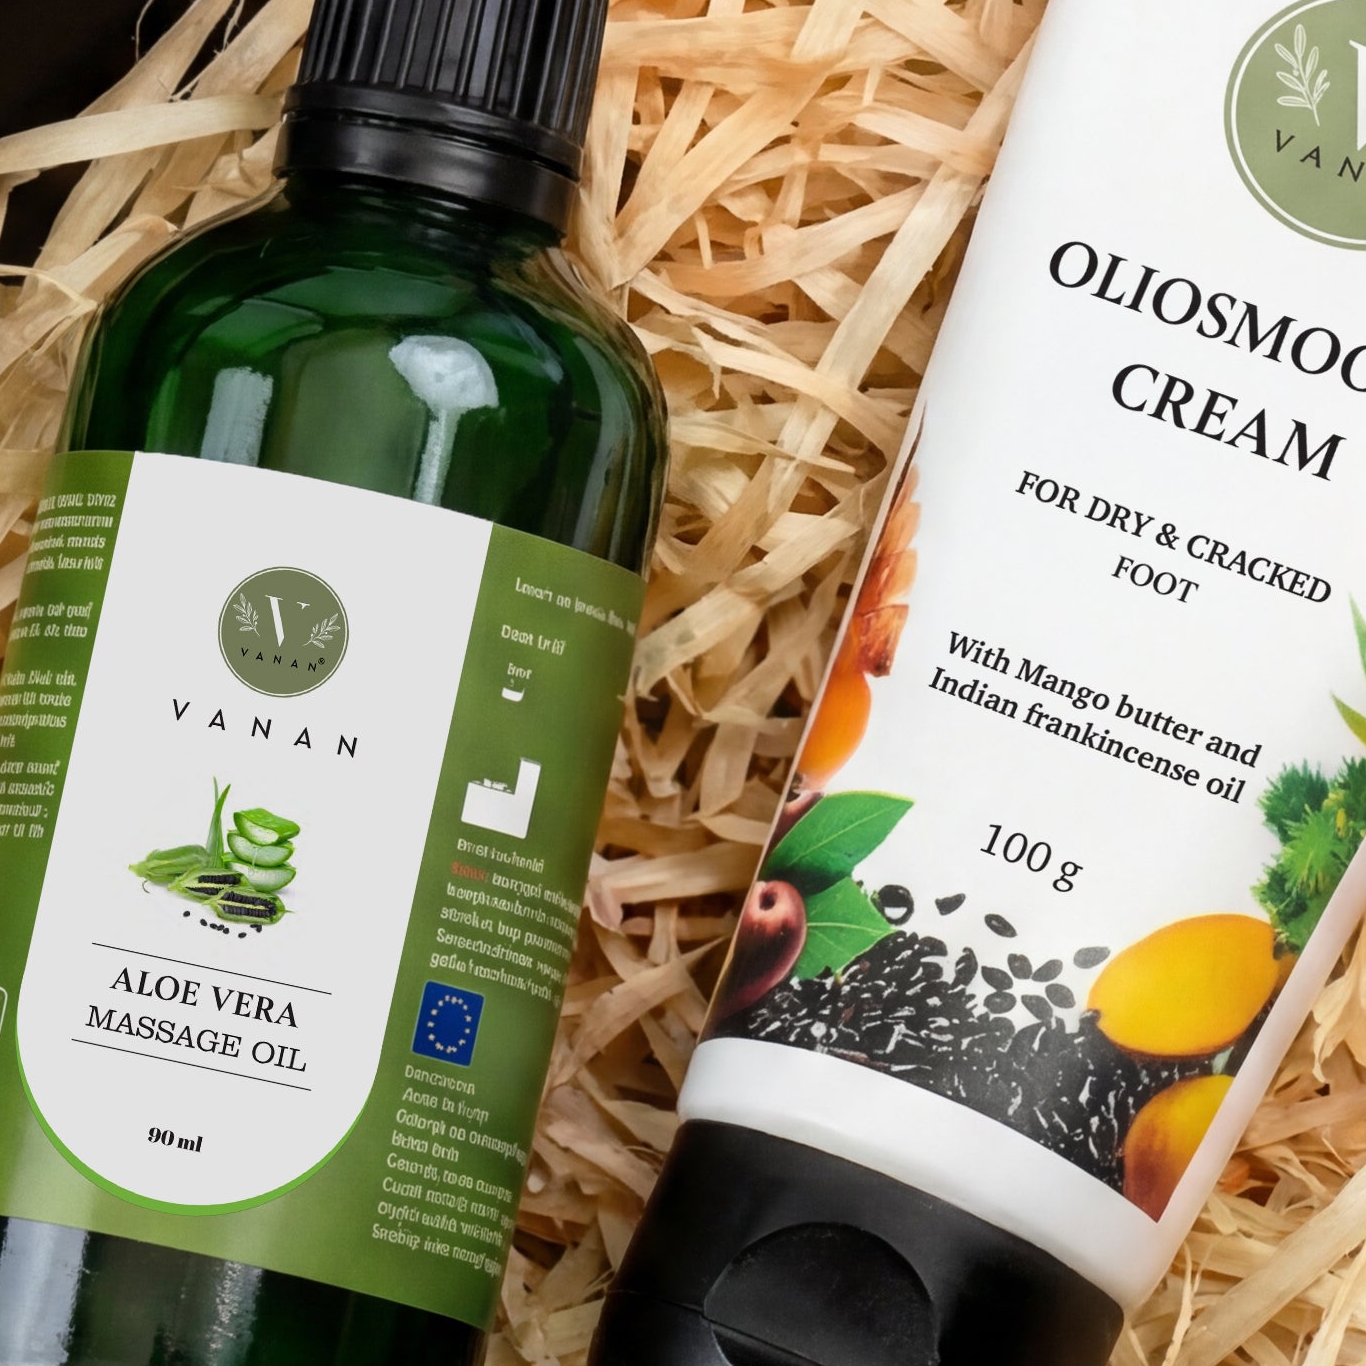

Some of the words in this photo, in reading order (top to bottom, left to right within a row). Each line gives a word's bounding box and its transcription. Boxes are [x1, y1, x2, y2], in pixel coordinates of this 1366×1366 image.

[1111, 363, 1347, 482] CREAM
[1015, 470, 1081, 514] FOR
[1084, 495, 1159, 540] DRY
[1155, 523, 1180, 551] &
[1185, 534, 1333, 604] CRACKED
[1111, 555, 1201, 604] FOOT
[172, 698, 358, 759] VANAN
[948, 631, 1011, 675] With
[1014, 657, 1110, 711] Mango
[1115, 694, 1204, 746] butter
[1205, 736, 1263, 768] and
[928, 666, 1019, 719] Indian
[1022, 702, 1200, 787] frankincense
[1206, 776, 1246, 804] oil
[980, 824, 1052, 873] 100
[1052, 861, 1084, 893] g
[109, 967, 201, 1007] ALOE
[211, 985, 298, 1028] VERA
[85, 1004, 242, 1058] MASSAGE
[251, 1041, 307, 1073] OIL
[147, 1127, 175, 1146] 90
[177, 1135, 204, 1153] ml
